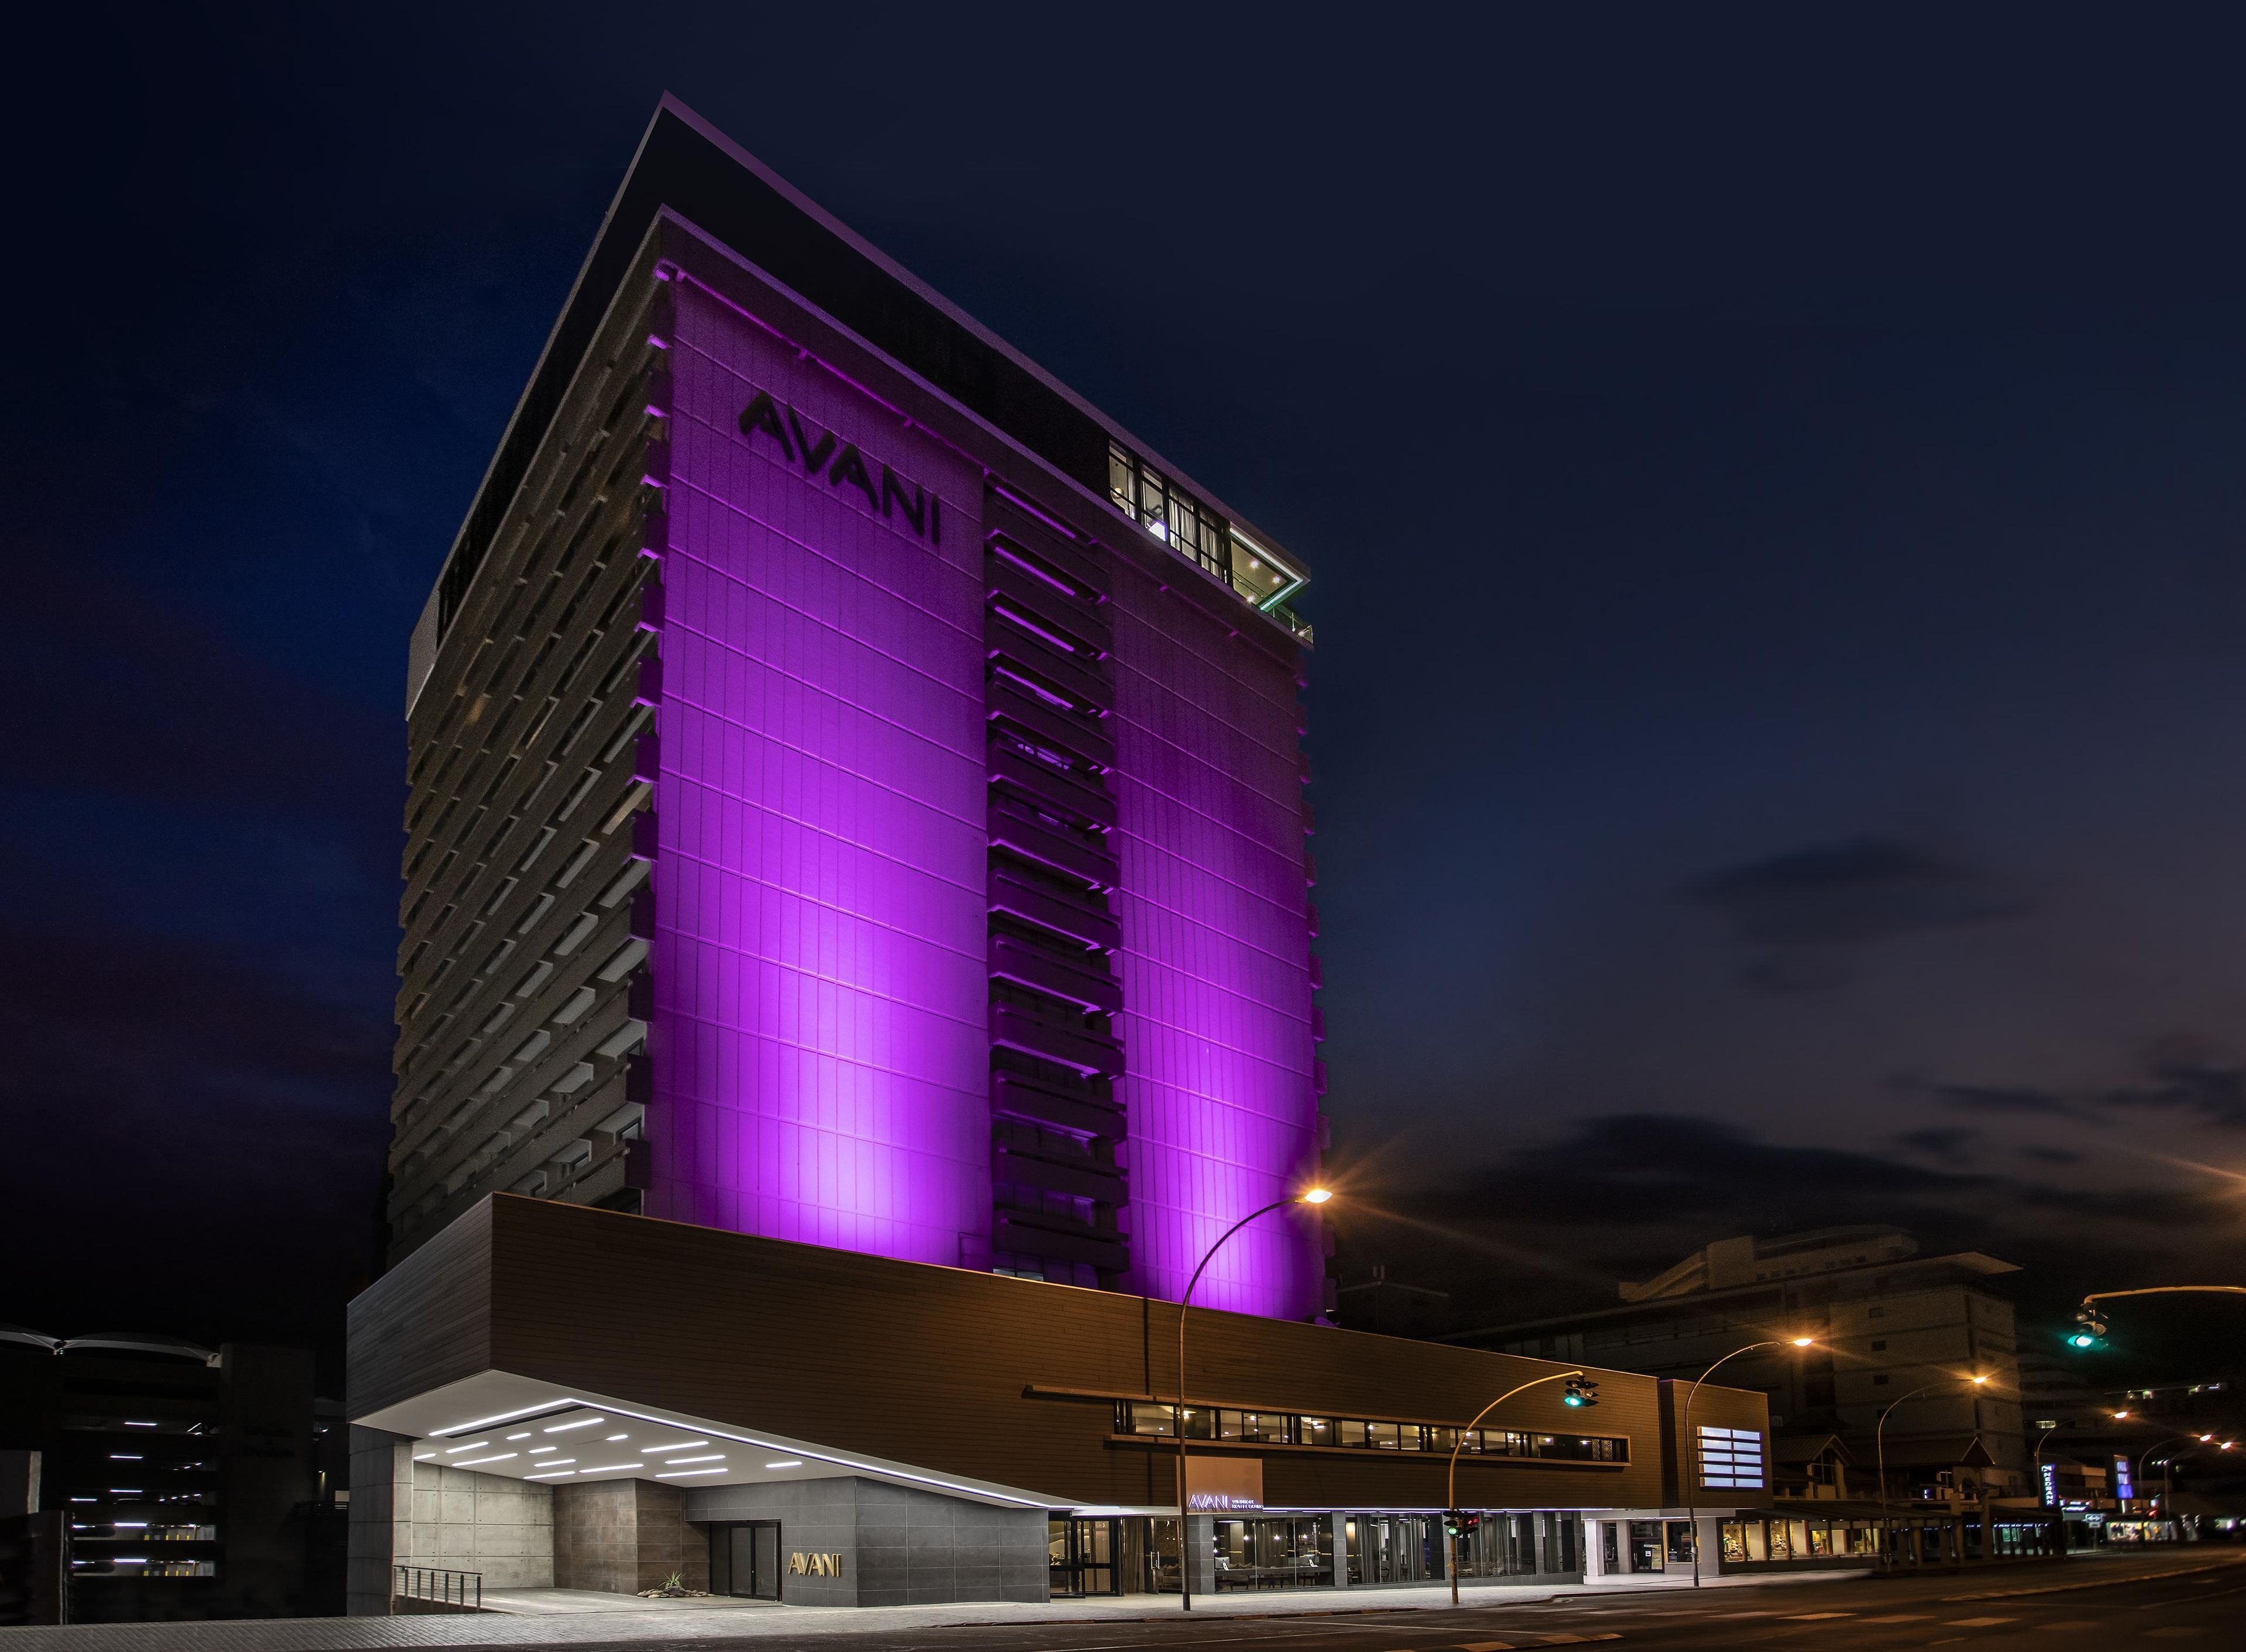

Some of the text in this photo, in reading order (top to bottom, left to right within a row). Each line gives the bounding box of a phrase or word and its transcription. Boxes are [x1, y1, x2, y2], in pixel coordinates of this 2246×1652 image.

[739, 390, 939, 544] AVANI
[1189, 1495, 1228, 1509] AVANI
[2044, 1472, 2053, 1505] NEDBANK
[788, 1553, 841, 1577] AVANI
